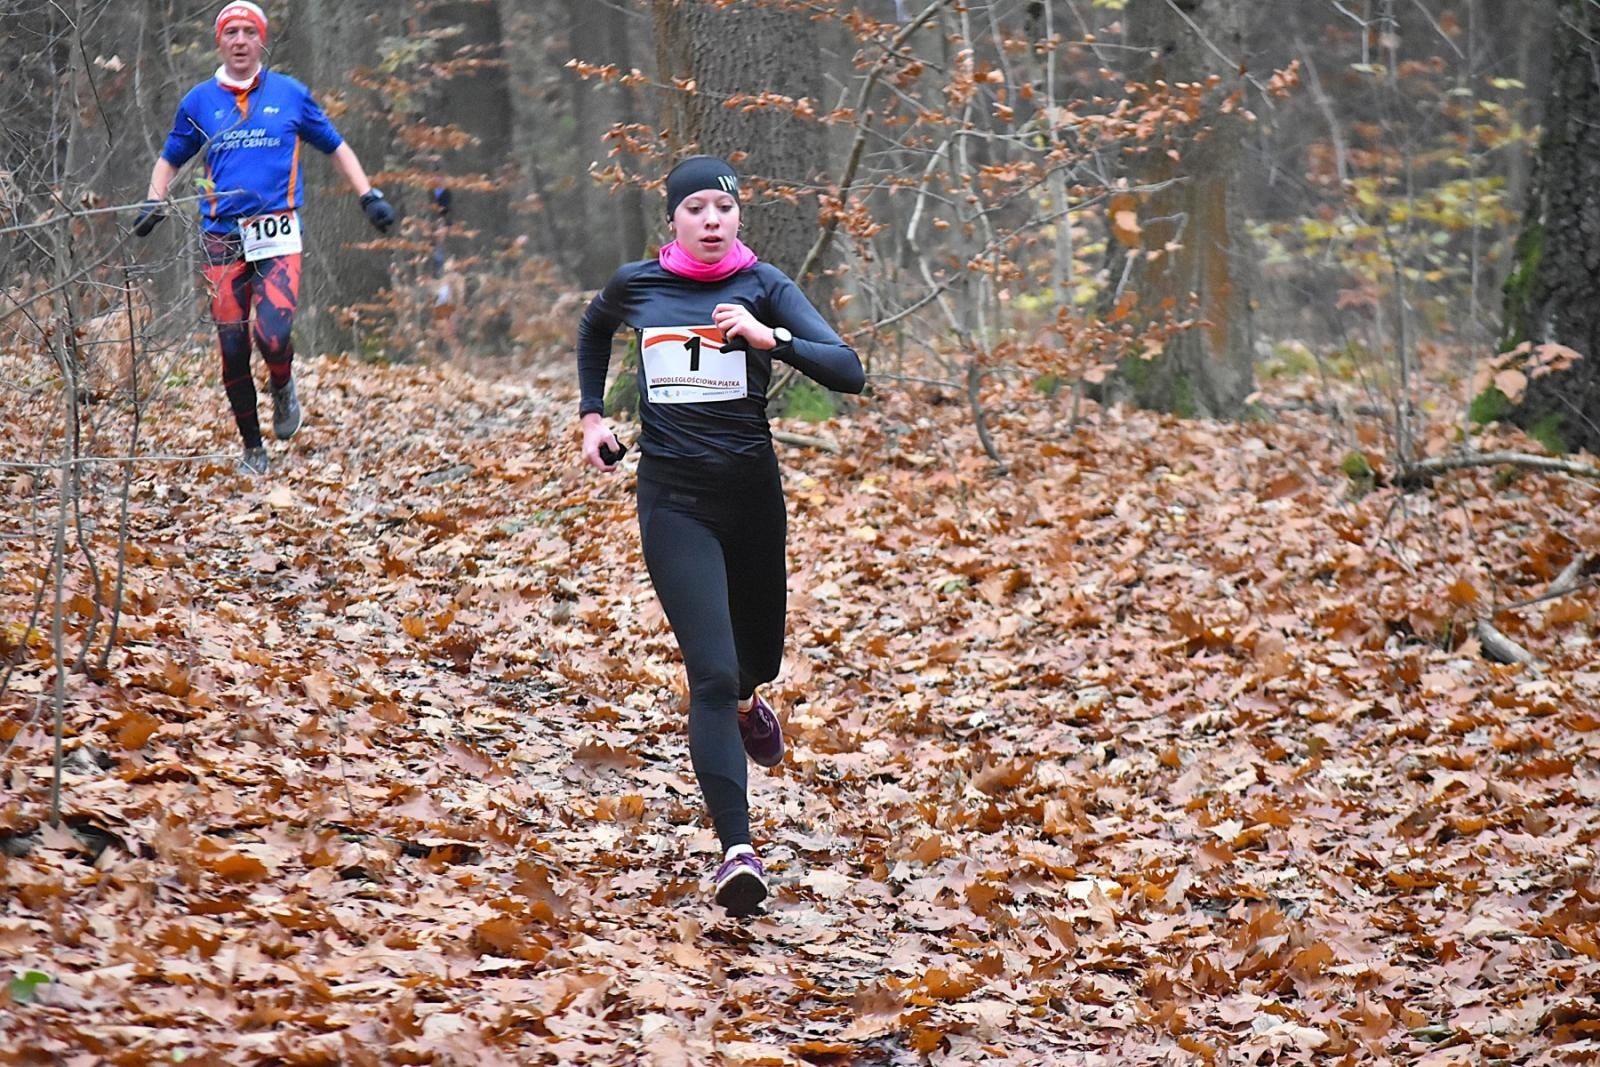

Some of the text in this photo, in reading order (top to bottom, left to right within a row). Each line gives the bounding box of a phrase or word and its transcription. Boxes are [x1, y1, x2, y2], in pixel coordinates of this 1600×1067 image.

[242, 137, 281, 149] CENTER
[251, 214, 292, 241] 108
[683, 336, 701, 372] 1
